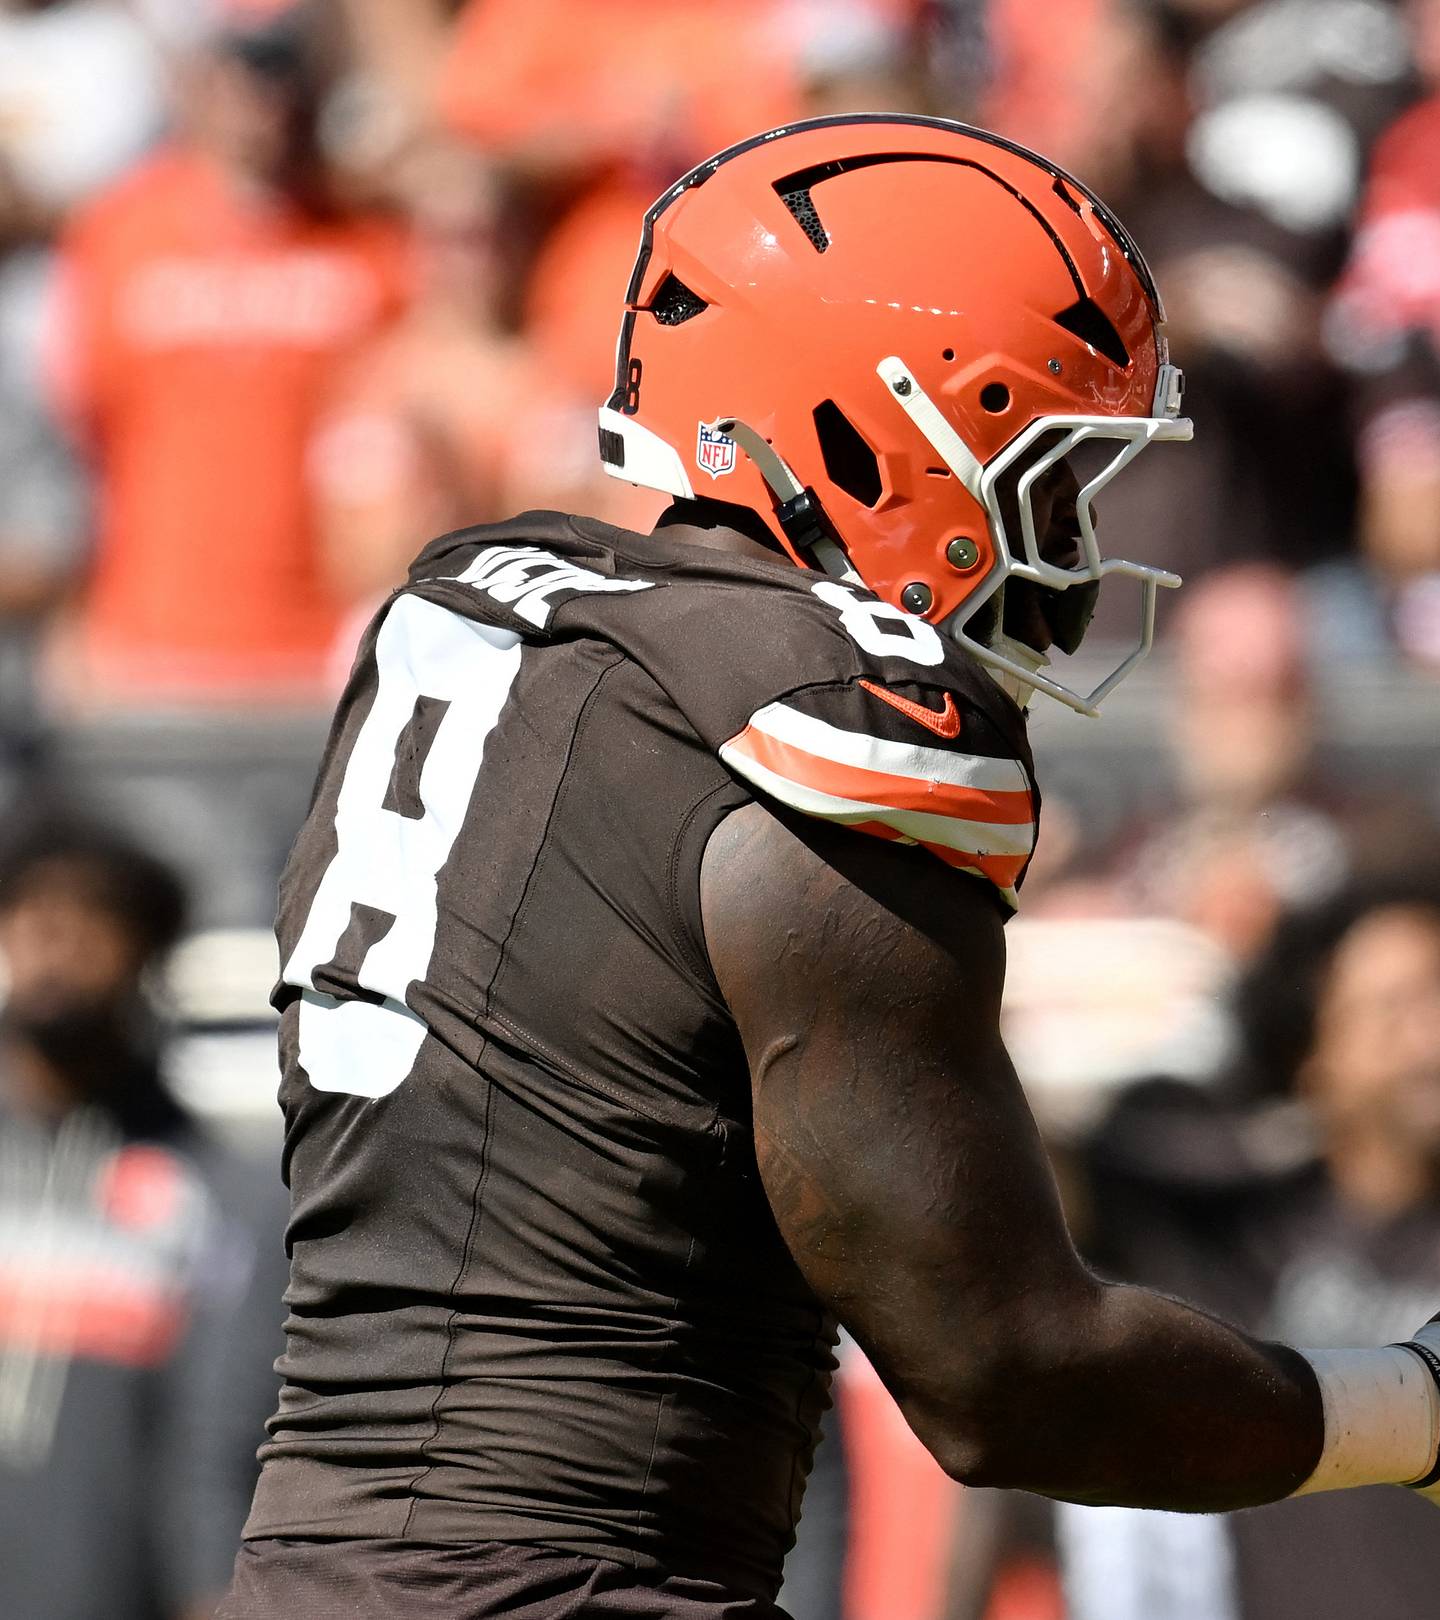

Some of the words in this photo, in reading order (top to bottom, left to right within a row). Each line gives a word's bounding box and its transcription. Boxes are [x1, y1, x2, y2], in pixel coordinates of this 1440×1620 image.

[622, 357, 643, 416] 8
[701, 443, 730, 469] NFL
[283, 592, 523, 1101] 8
